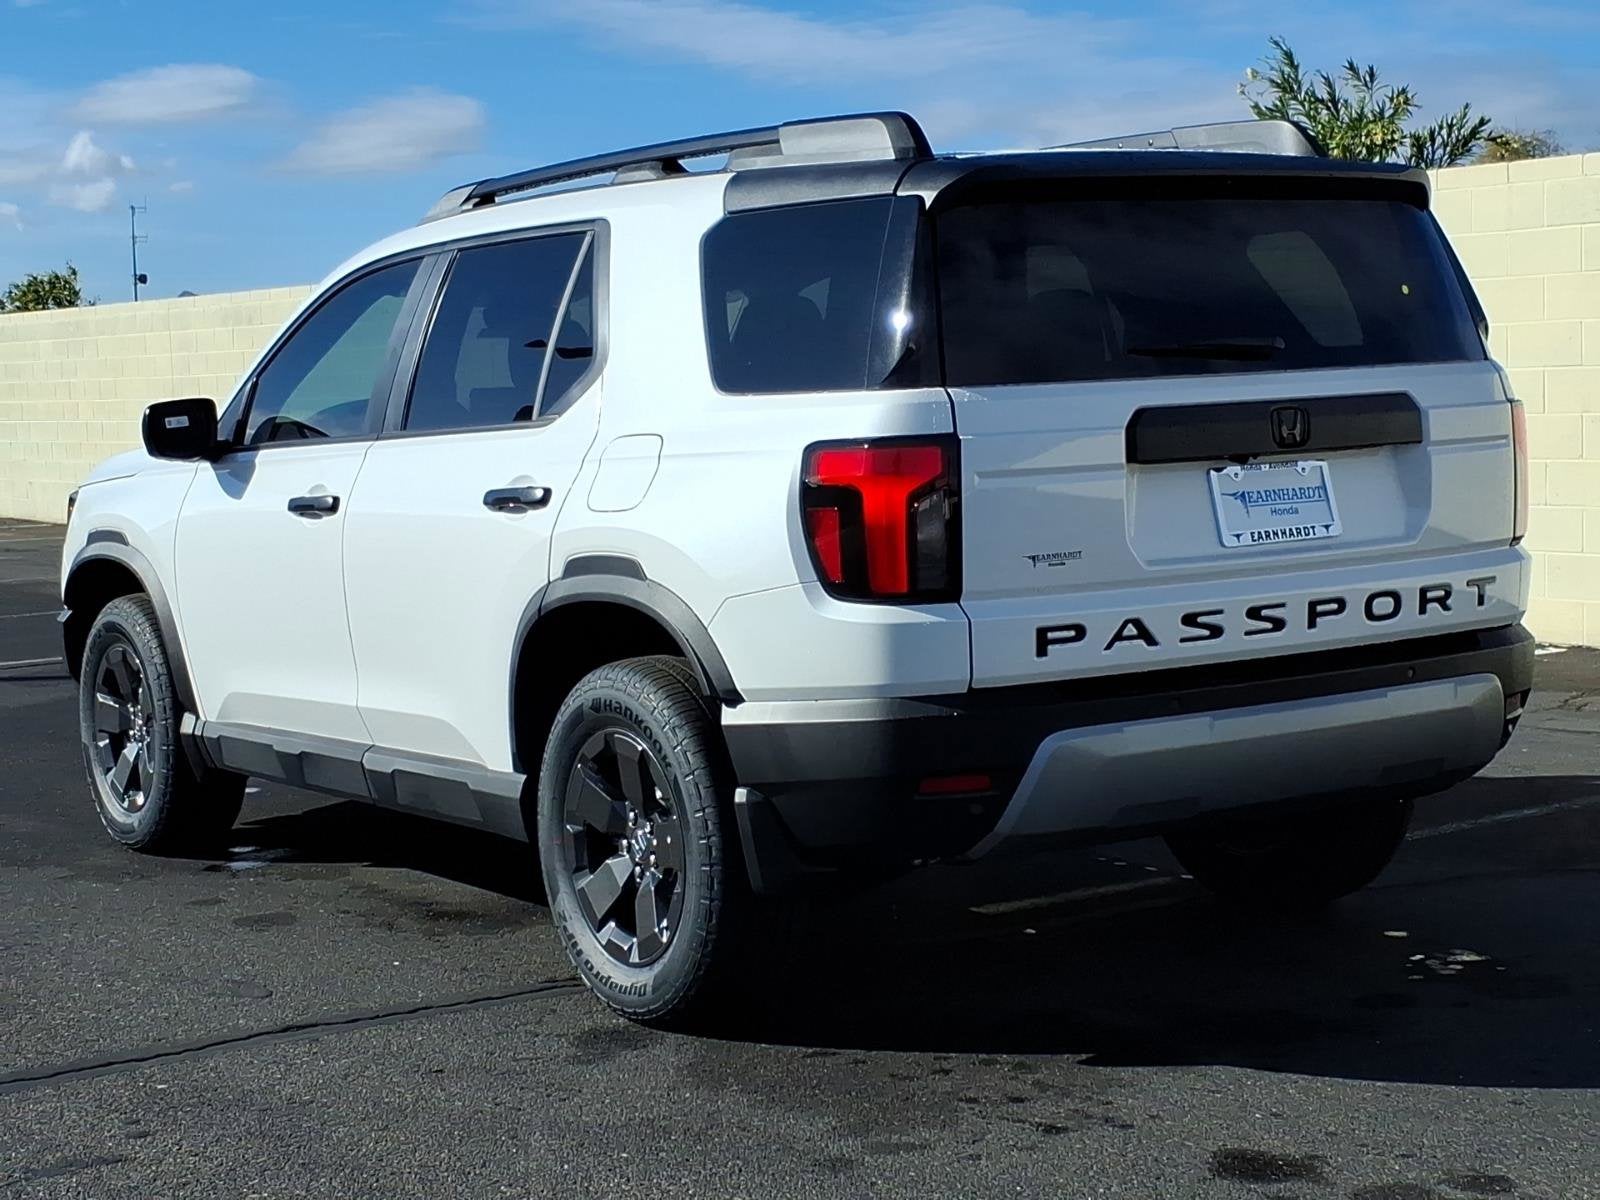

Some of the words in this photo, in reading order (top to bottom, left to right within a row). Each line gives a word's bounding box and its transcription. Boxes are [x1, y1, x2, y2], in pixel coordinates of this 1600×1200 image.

[1247, 485, 1325, 503] EARNHARDT
[1270, 505, 1299, 517] Honda
[1250, 525, 1317, 542] EARNHARDT
[1035, 575, 1497, 658] PASSPORT
